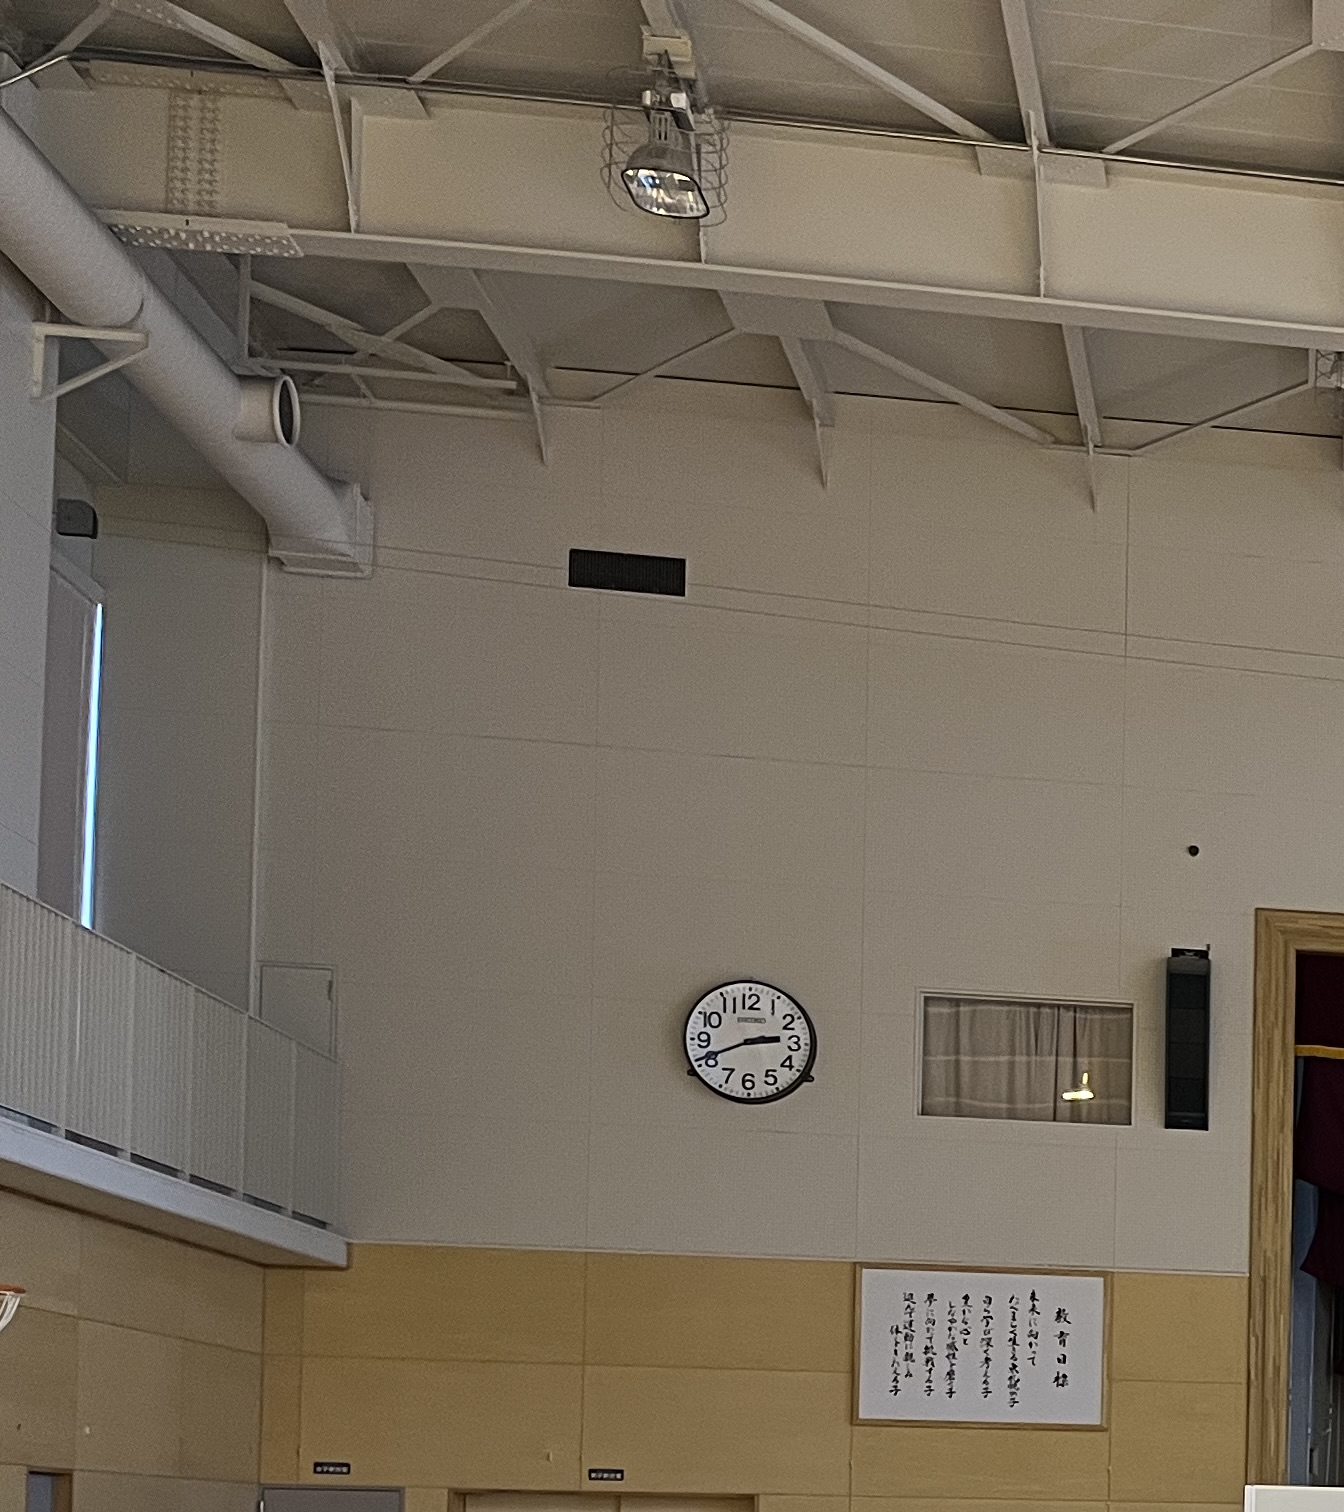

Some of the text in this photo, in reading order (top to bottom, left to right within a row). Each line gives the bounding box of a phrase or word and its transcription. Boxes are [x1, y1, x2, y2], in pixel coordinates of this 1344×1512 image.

[722, 996, 736, 1014] 11
[742, 992, 761, 1011] 12
[771, 999, 775, 1016] 1
[703, 1011, 722, 1029] 10
[782, 1013, 795, 1031] 2
[697, 1031, 711, 1049] 9
[787, 1034, 801, 1052] 3
[780, 1055, 795, 1071] 4
[721, 1067, 736, 1085] 7
[741, 1073, 756, 1091] 6
[763, 1069, 778, 1086] 5
[1053, 1307, 1072, 1388] 教育目標
